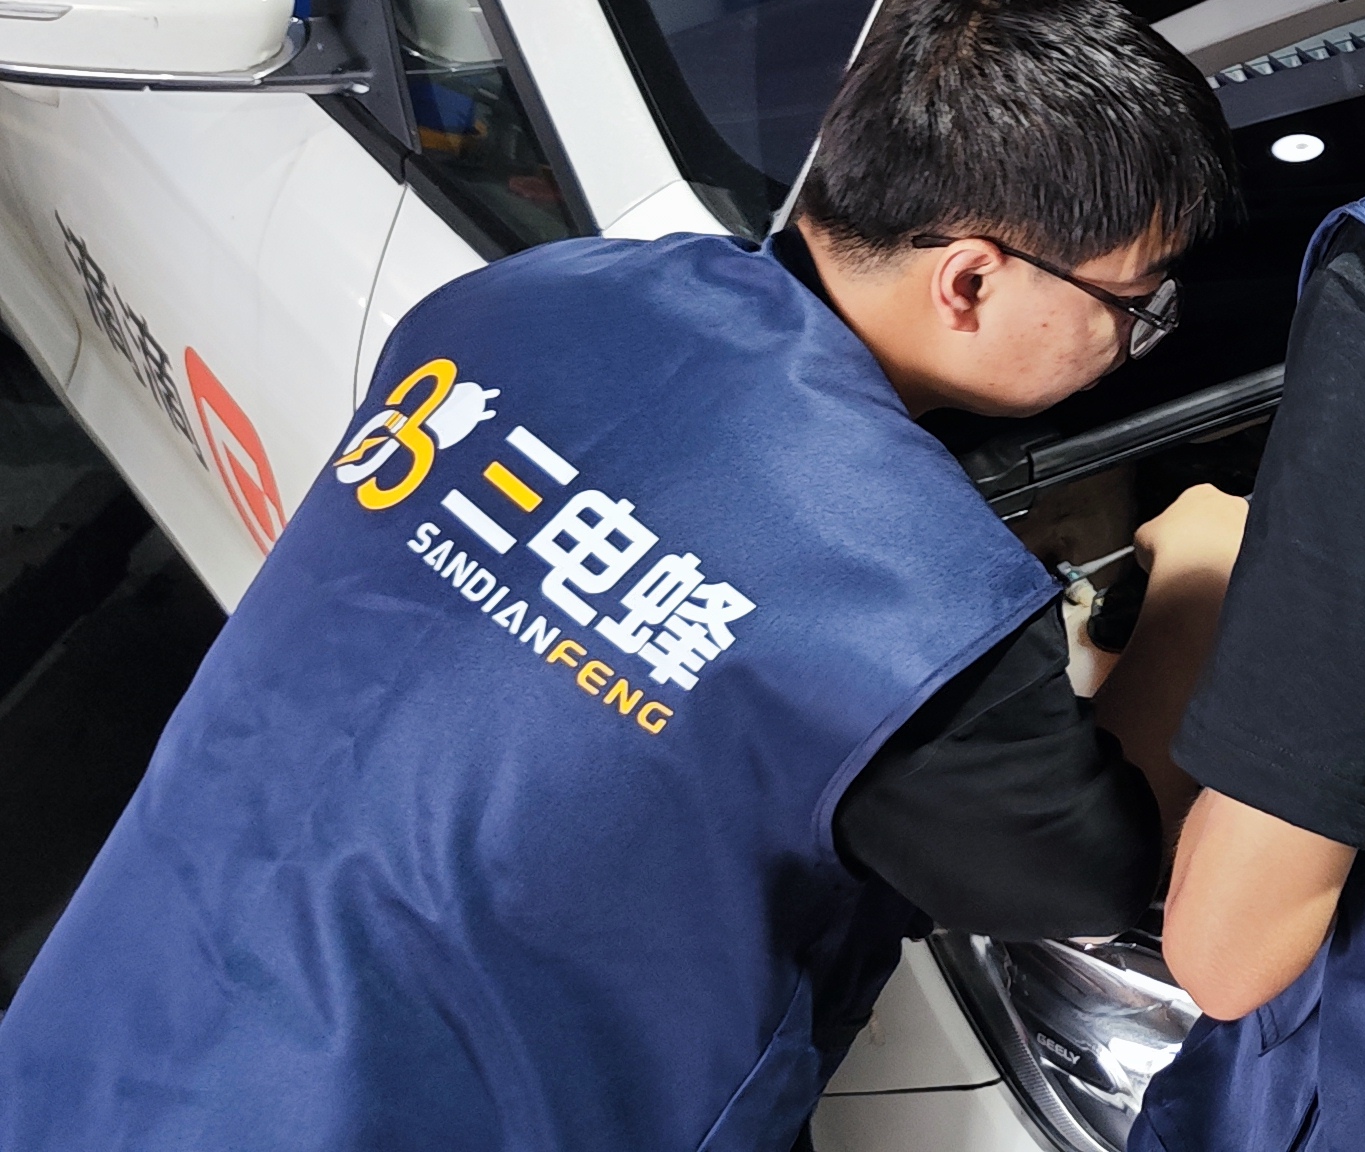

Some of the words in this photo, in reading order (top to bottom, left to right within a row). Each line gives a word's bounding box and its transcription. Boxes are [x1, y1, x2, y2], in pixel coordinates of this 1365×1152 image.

[407, 521, 674, 735] SANDIANFENG
[441, 425, 757, 691] 三电蜂
[1036, 1032, 1080, 1064] GEELY
